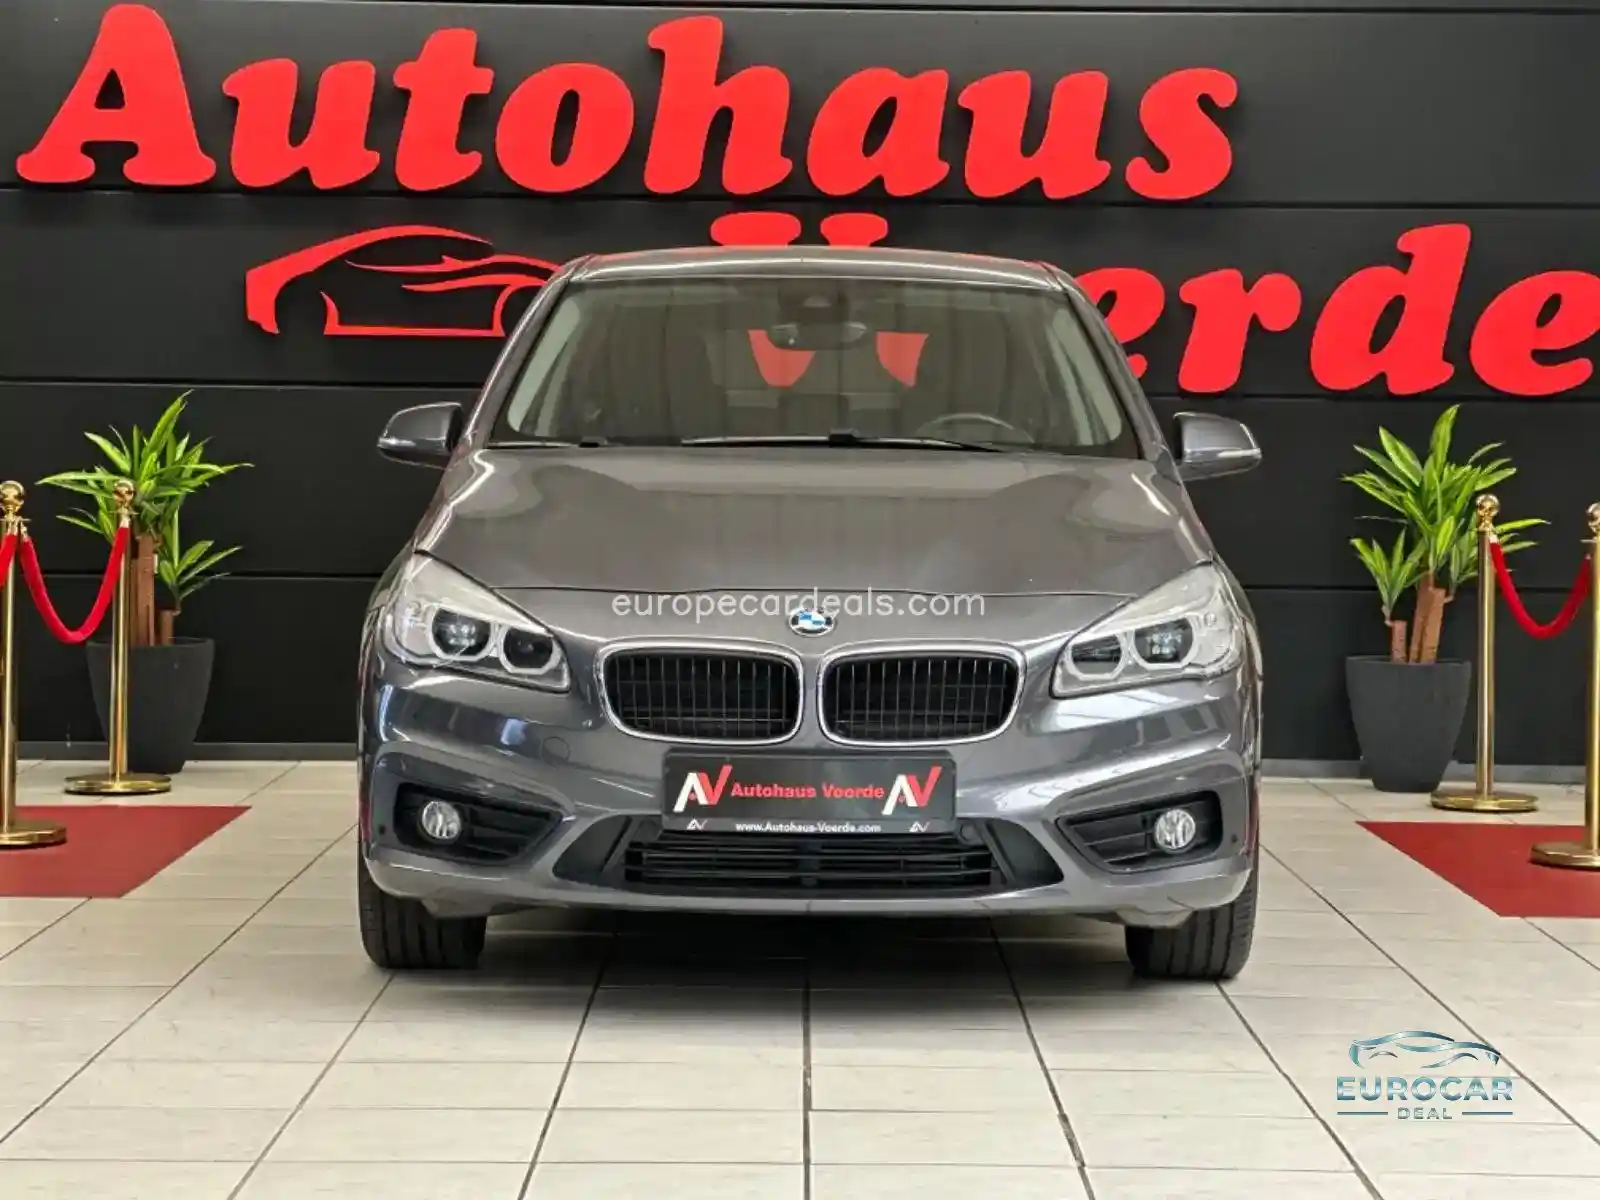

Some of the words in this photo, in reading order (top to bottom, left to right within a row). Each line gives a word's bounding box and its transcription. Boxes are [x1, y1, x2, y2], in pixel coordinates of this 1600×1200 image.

[16, 3, 1238, 200] Autohaus
[730, 782, 817, 799] Autohaus
[821, 783, 885, 799] Voerde
[735, 821, 882, 833] www.Autohaus-Voerde.com
